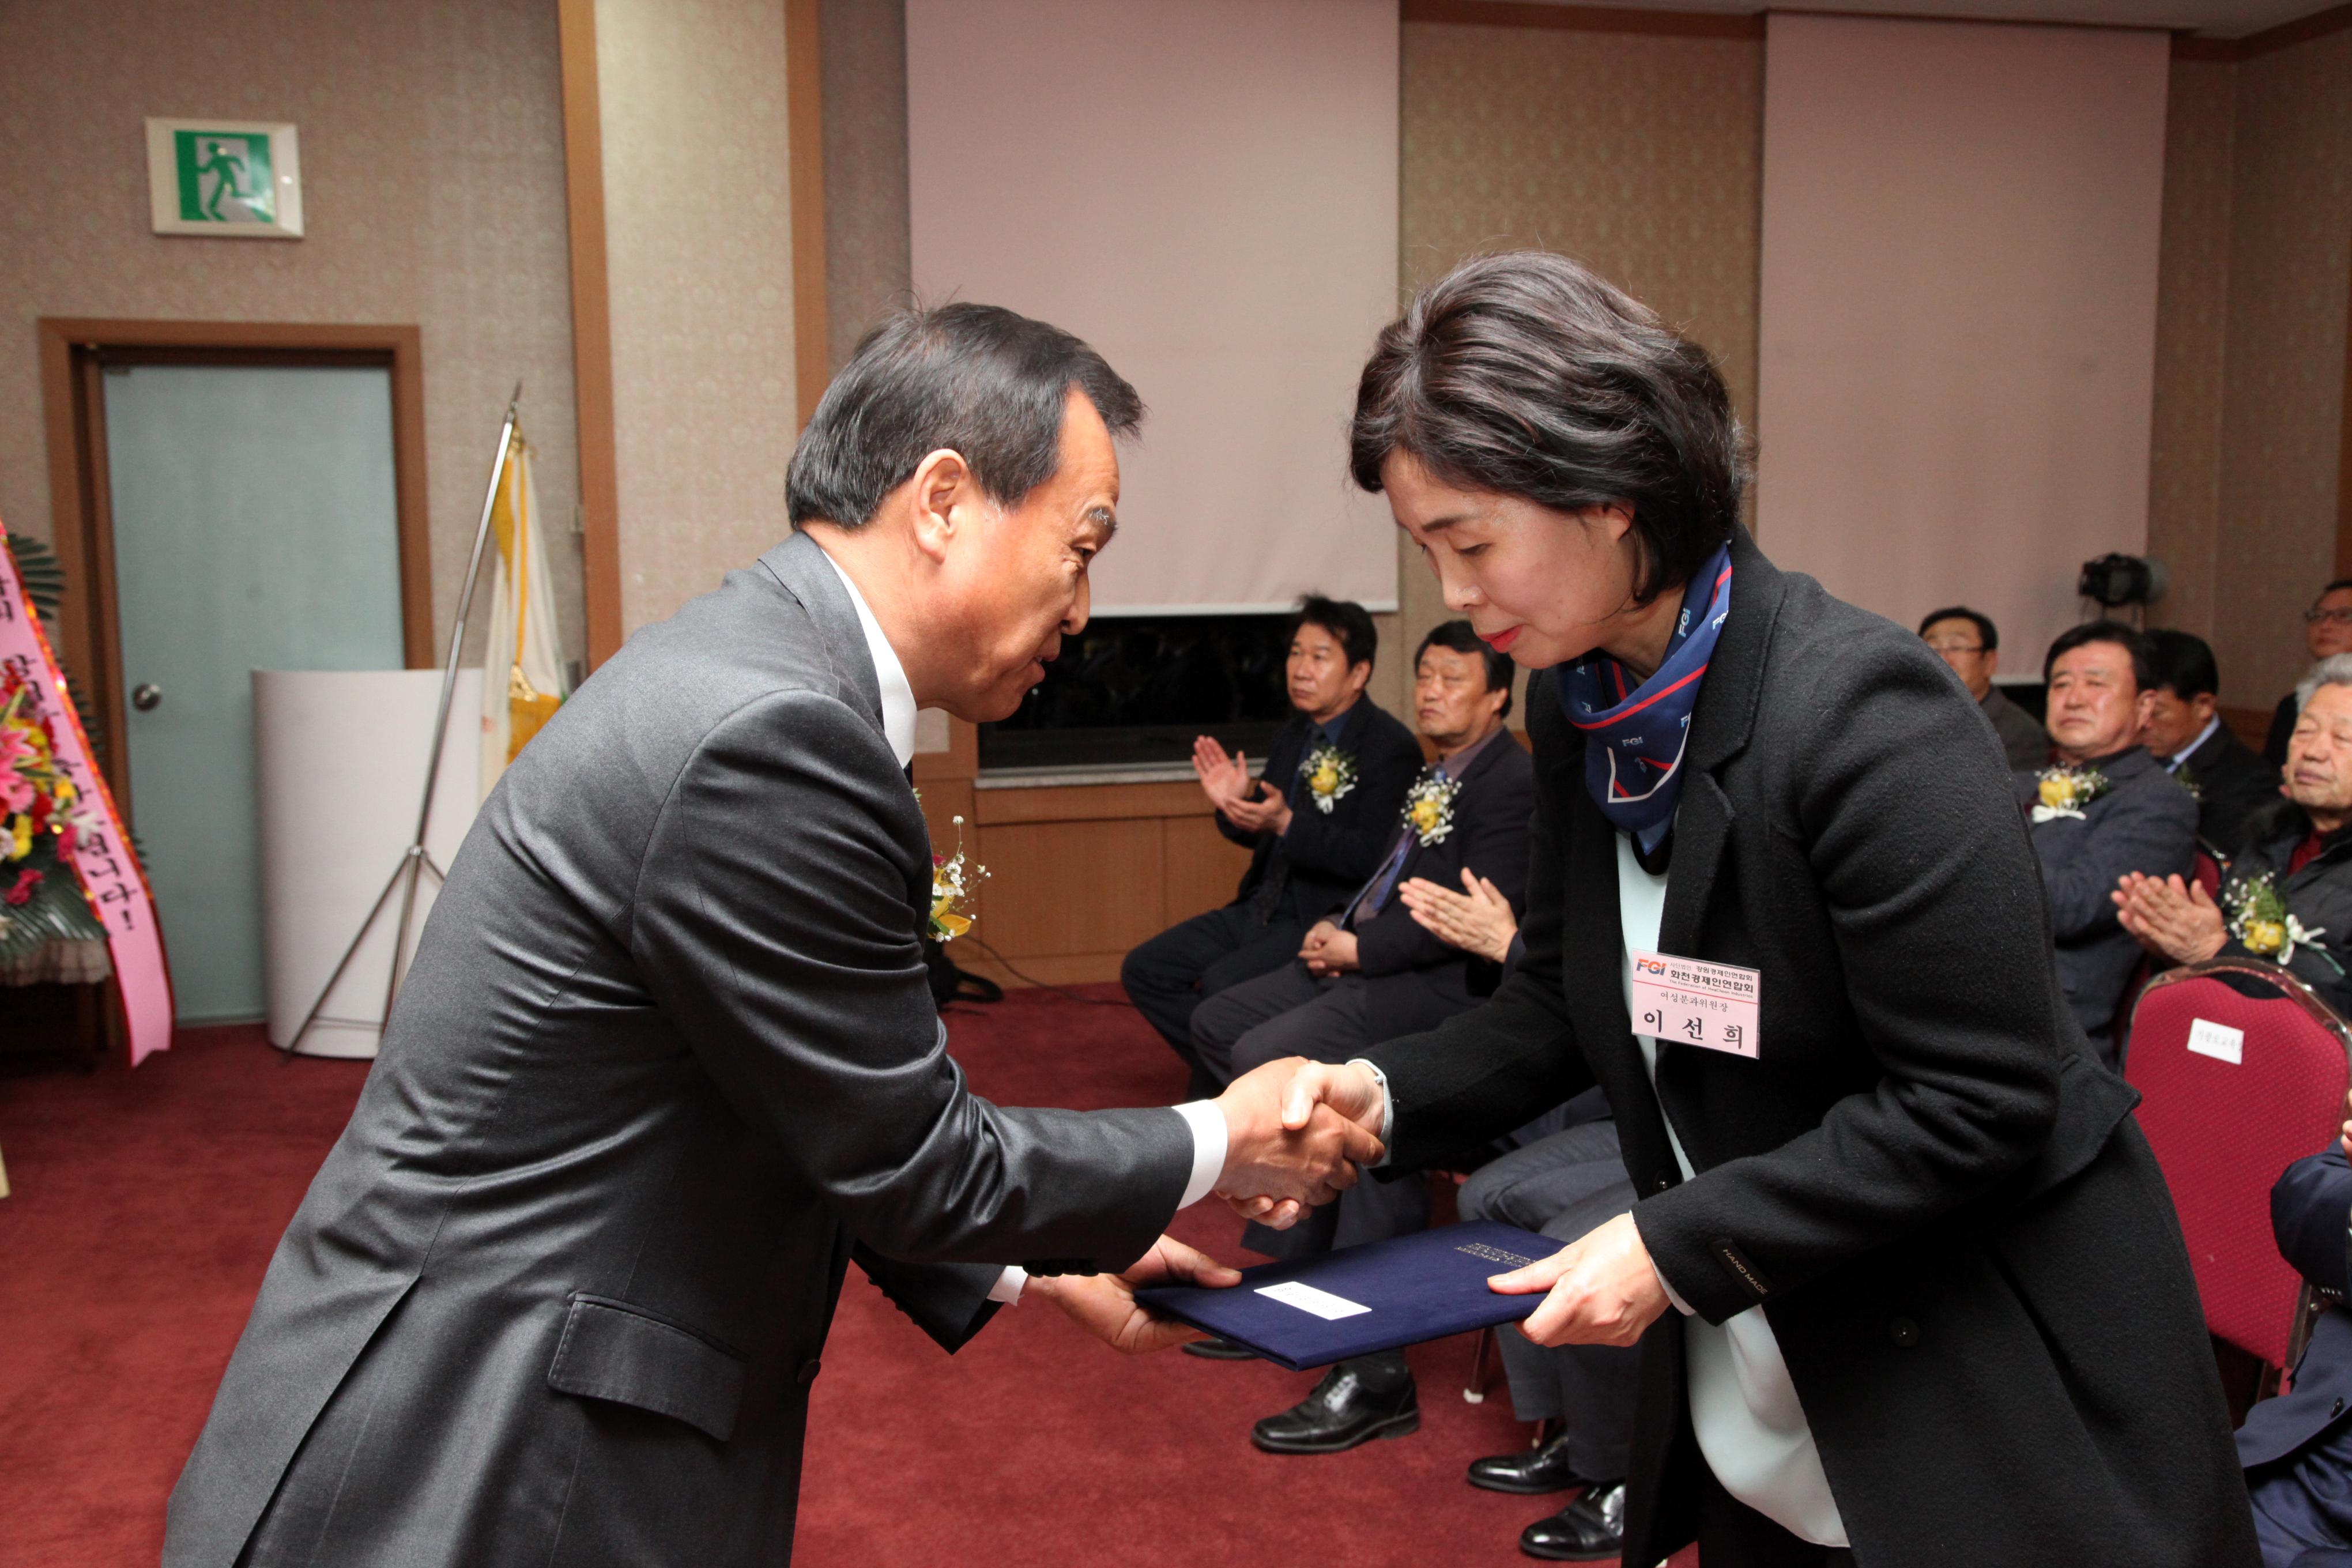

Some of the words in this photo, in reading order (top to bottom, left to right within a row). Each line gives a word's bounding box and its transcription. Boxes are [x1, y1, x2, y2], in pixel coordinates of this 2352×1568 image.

[1679, 608, 1691, 638] FGI
[1622, 737, 1644, 747] FGI
[1637, 959, 1667, 975] FGI
[1670, 963, 1691, 971] 사단법인
[1671, 970, 1753, 993] 화천경제인연합회
[1660, 992, 1728, 1012] 여성분과위원장
[1722, 1249, 1746, 1273] HAND
[1744, 1273, 1768, 1294] MADE
